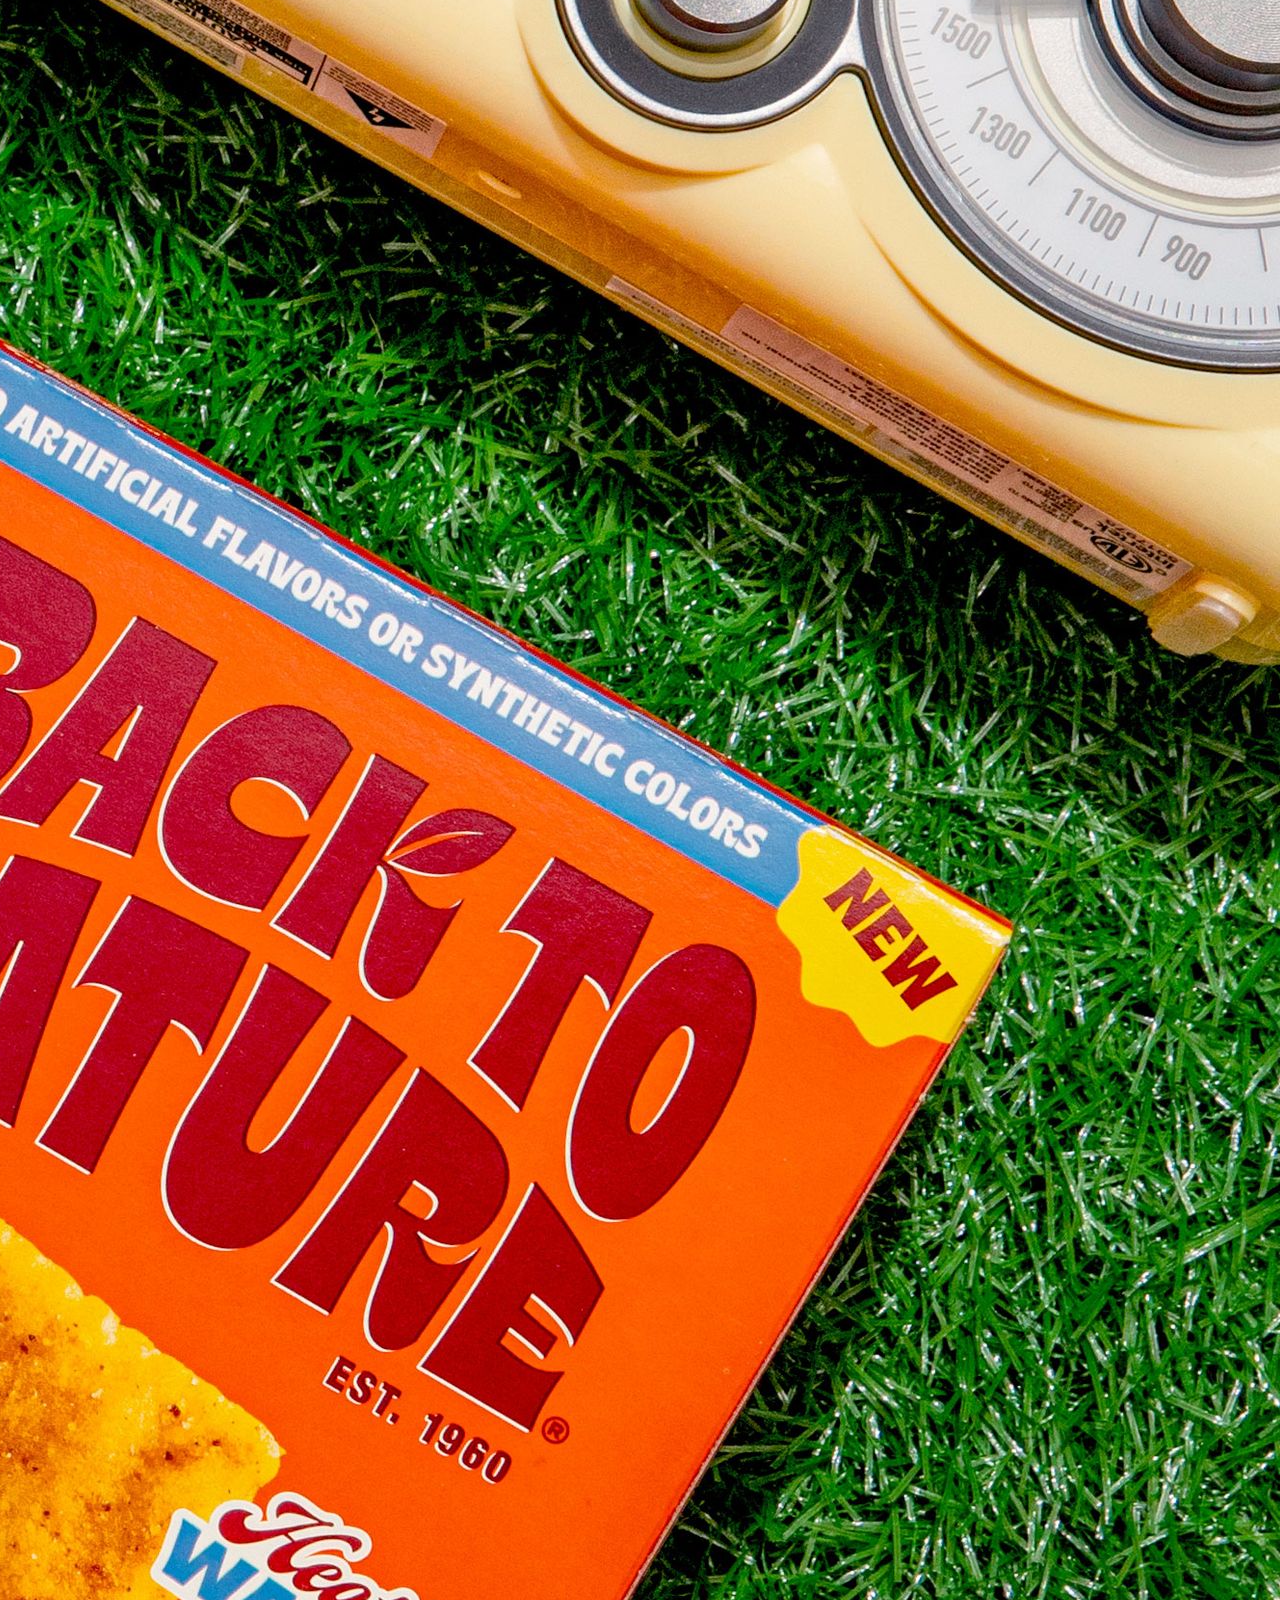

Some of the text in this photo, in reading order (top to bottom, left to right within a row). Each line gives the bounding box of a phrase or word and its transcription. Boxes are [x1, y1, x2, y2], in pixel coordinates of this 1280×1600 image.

[929, 7, 993, 60] 1500
[967, 106, 1032, 160] 1300
[1063, 187, 1128, 242] 1100
[1160, 235, 1212, 281] 900
[4, 402, 199, 538] ARTIFICIAL
[202, 515, 369, 630] FLAVORS
[367, 612, 419, 664] OR
[421, 642, 626, 778] SYNTHETIC
[623, 760, 769, 861] COLORS
[822, 867, 959, 1012] NEW
[466, 855, 757, 1224] TO
[322, 1355, 513, 1484] EST. 1960
